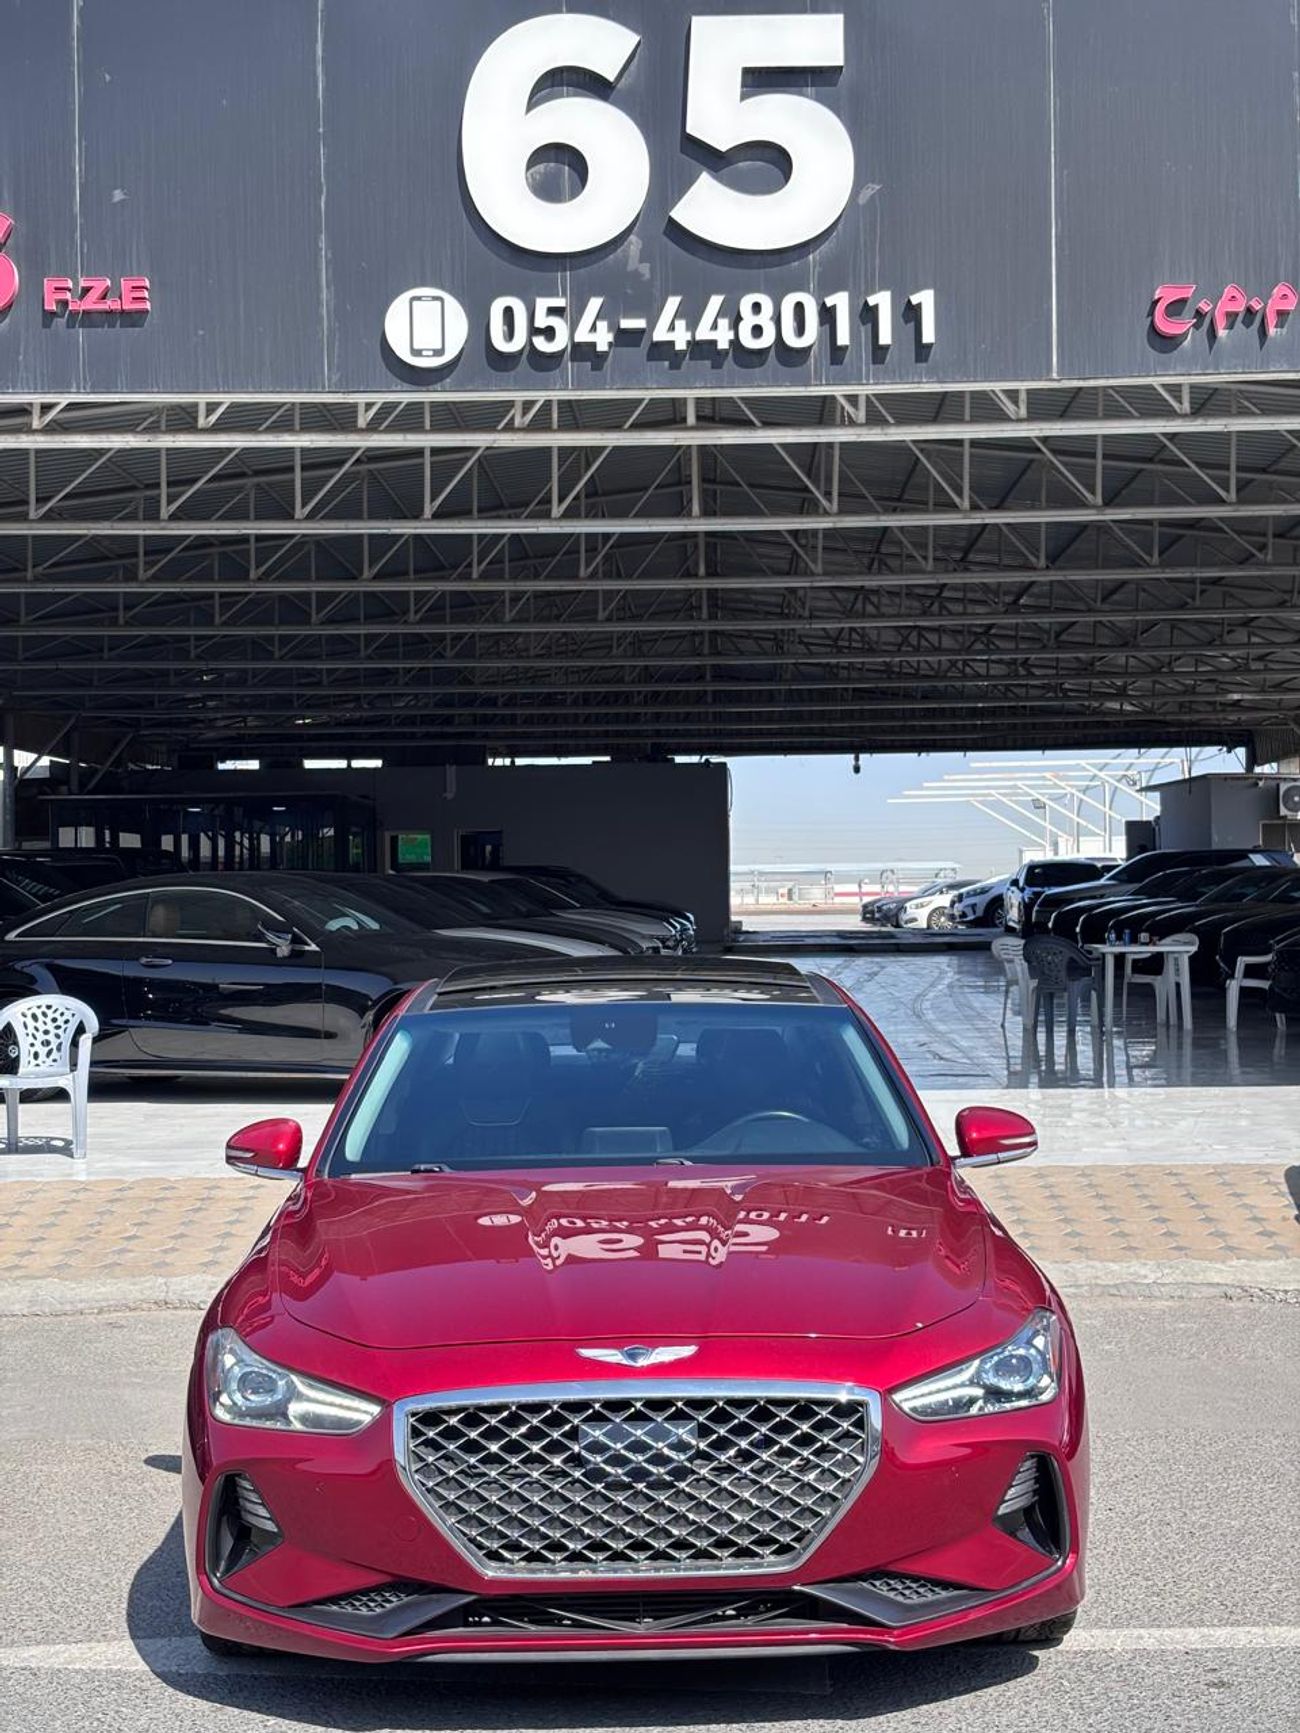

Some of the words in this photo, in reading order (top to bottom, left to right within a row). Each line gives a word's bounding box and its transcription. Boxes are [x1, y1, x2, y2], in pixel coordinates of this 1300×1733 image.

[462, 13, 854, 254] 65
[43, 276, 151, 312] F.Z.E
[489, 289, 935, 355] 054-4480111
